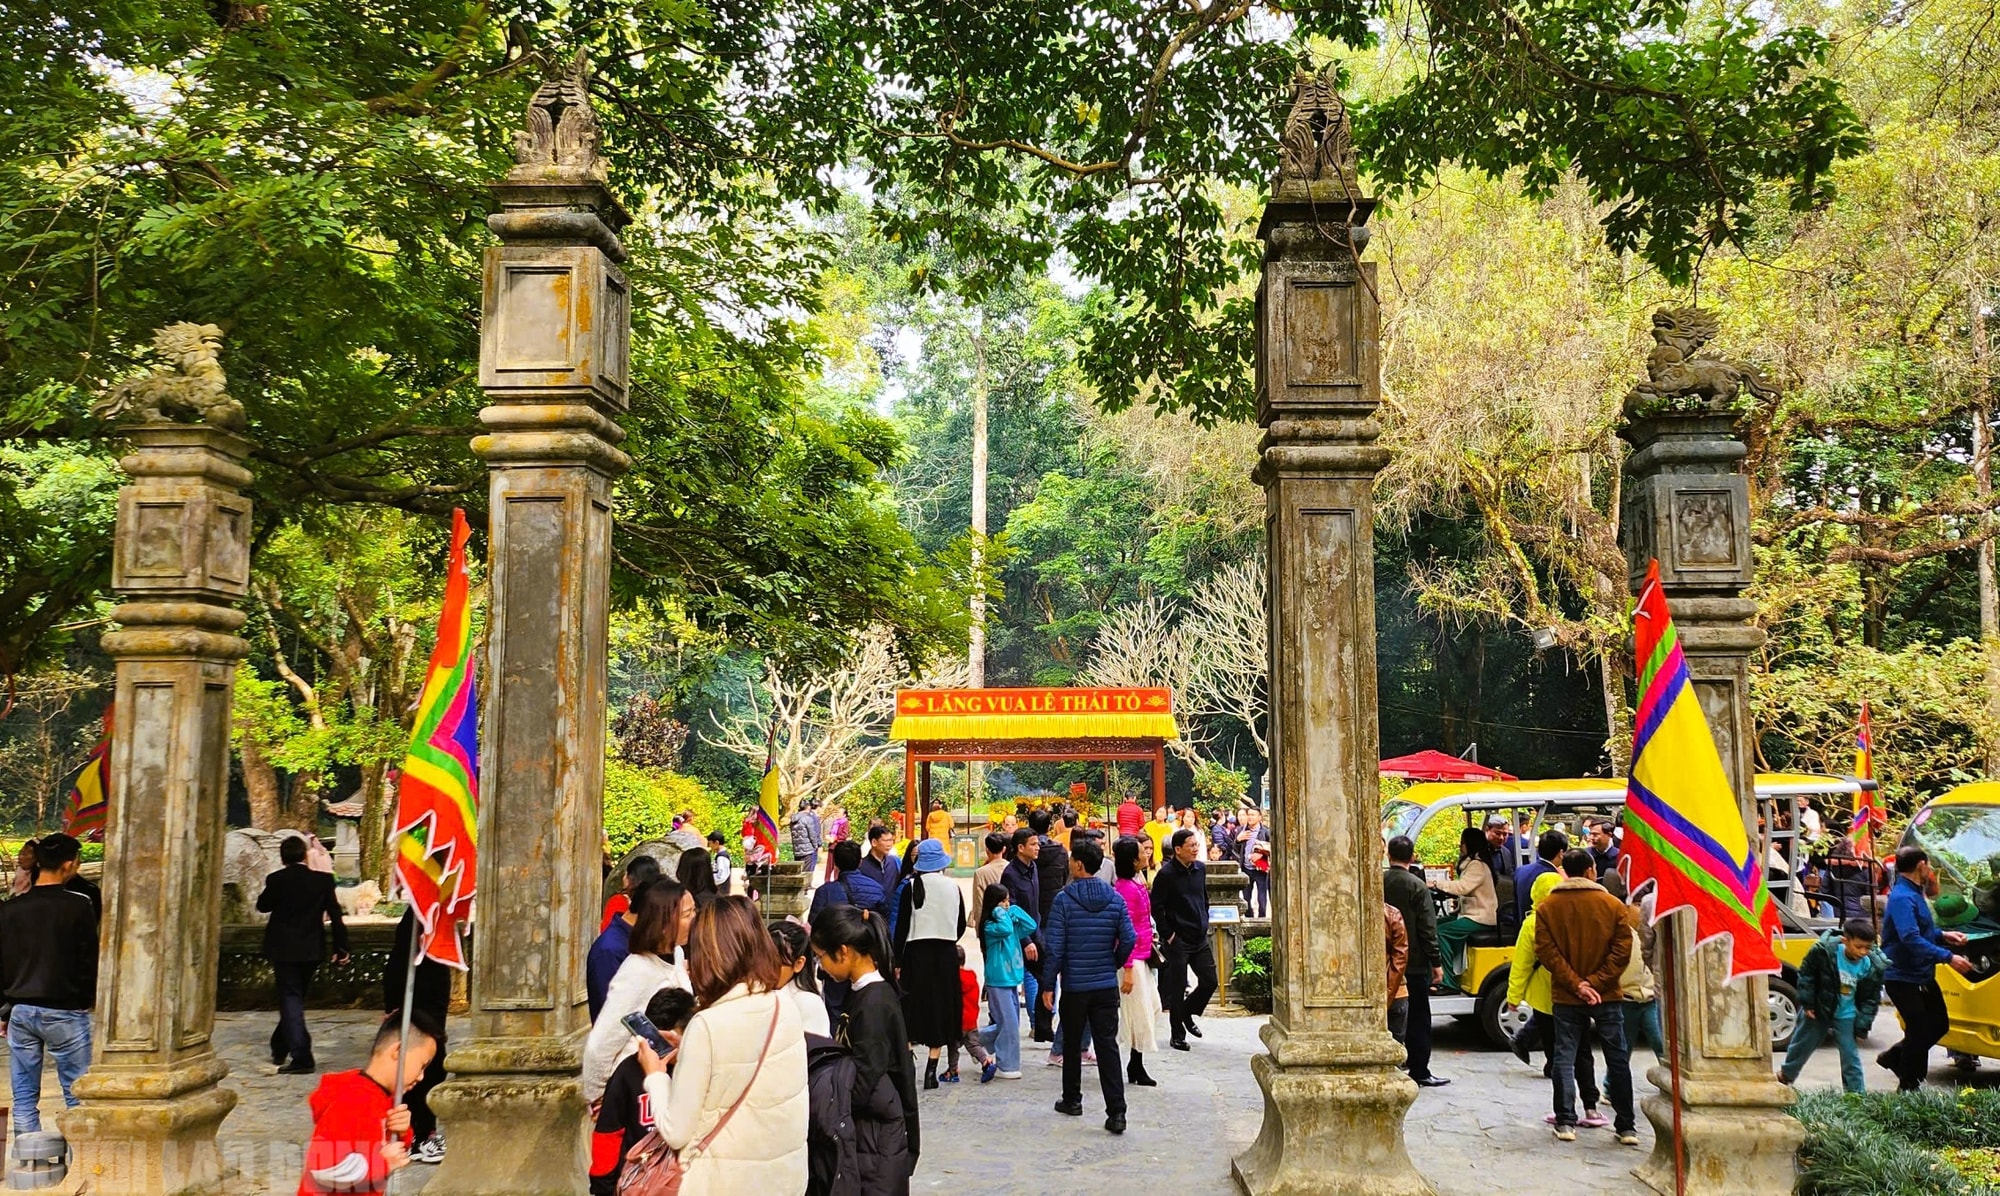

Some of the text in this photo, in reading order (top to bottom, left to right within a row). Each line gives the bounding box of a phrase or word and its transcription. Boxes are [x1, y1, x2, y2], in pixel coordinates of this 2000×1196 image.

[927, 693, 981, 712] LĂNG
[986, 696, 1027, 711] VUA
[1031, 691, 1056, 711] LÊ
[1060, 691, 1108, 711] THÁI
